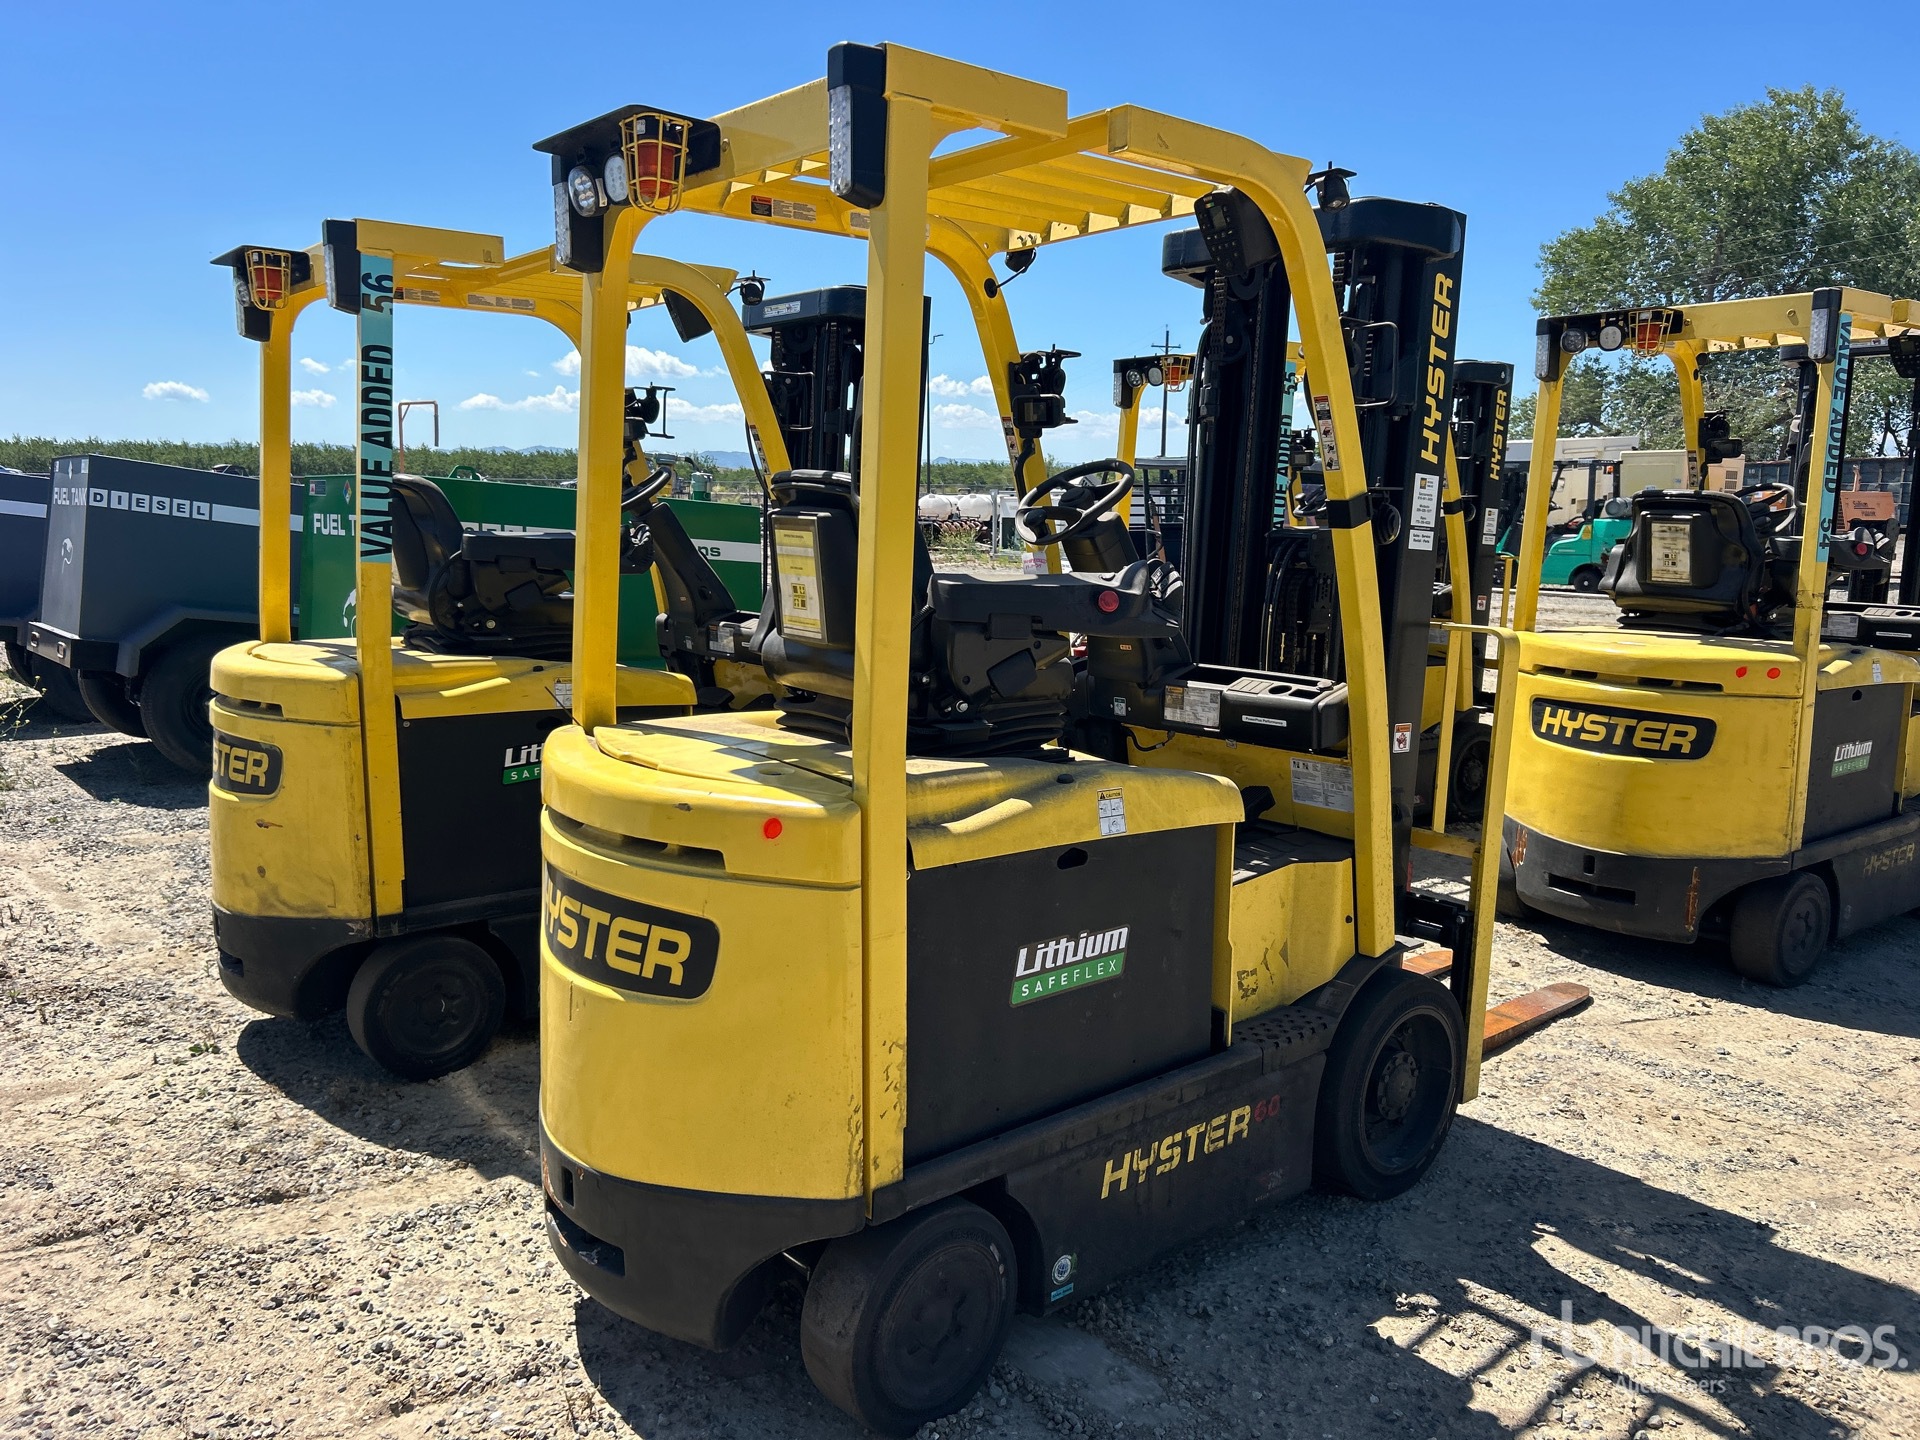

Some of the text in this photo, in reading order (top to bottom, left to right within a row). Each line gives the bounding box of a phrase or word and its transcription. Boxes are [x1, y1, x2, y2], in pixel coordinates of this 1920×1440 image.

[1420, 272, 1453, 465] HYSTER
[361, 272, 393, 557] VALUE ADDED 56
[1489, 389, 1508, 481] HYSTER
[1819, 319, 1851, 550] VALUE ADDED 54
[53, 487, 88, 506] FUEL TANK
[93, 492, 206, 516] DIESEL
[1273, 486, 1287, 530] ALUE
[313, 513, 346, 536] FUEL
[1540, 706, 1698, 754] HYSTER
[1834, 741, 1873, 762] Lithium
[212, 738, 270, 788] STER
[504, 743, 545, 768] Lit
[510, 767, 541, 780] SAF
[1864, 842, 1915, 877] HYSTER
[545, 878, 692, 986] HYSTER
[1015, 927, 1129, 978] Lithium
[1021, 959, 1117, 997] SAFEFLEX
[1101, 1104, 1251, 1200] HYSTER
